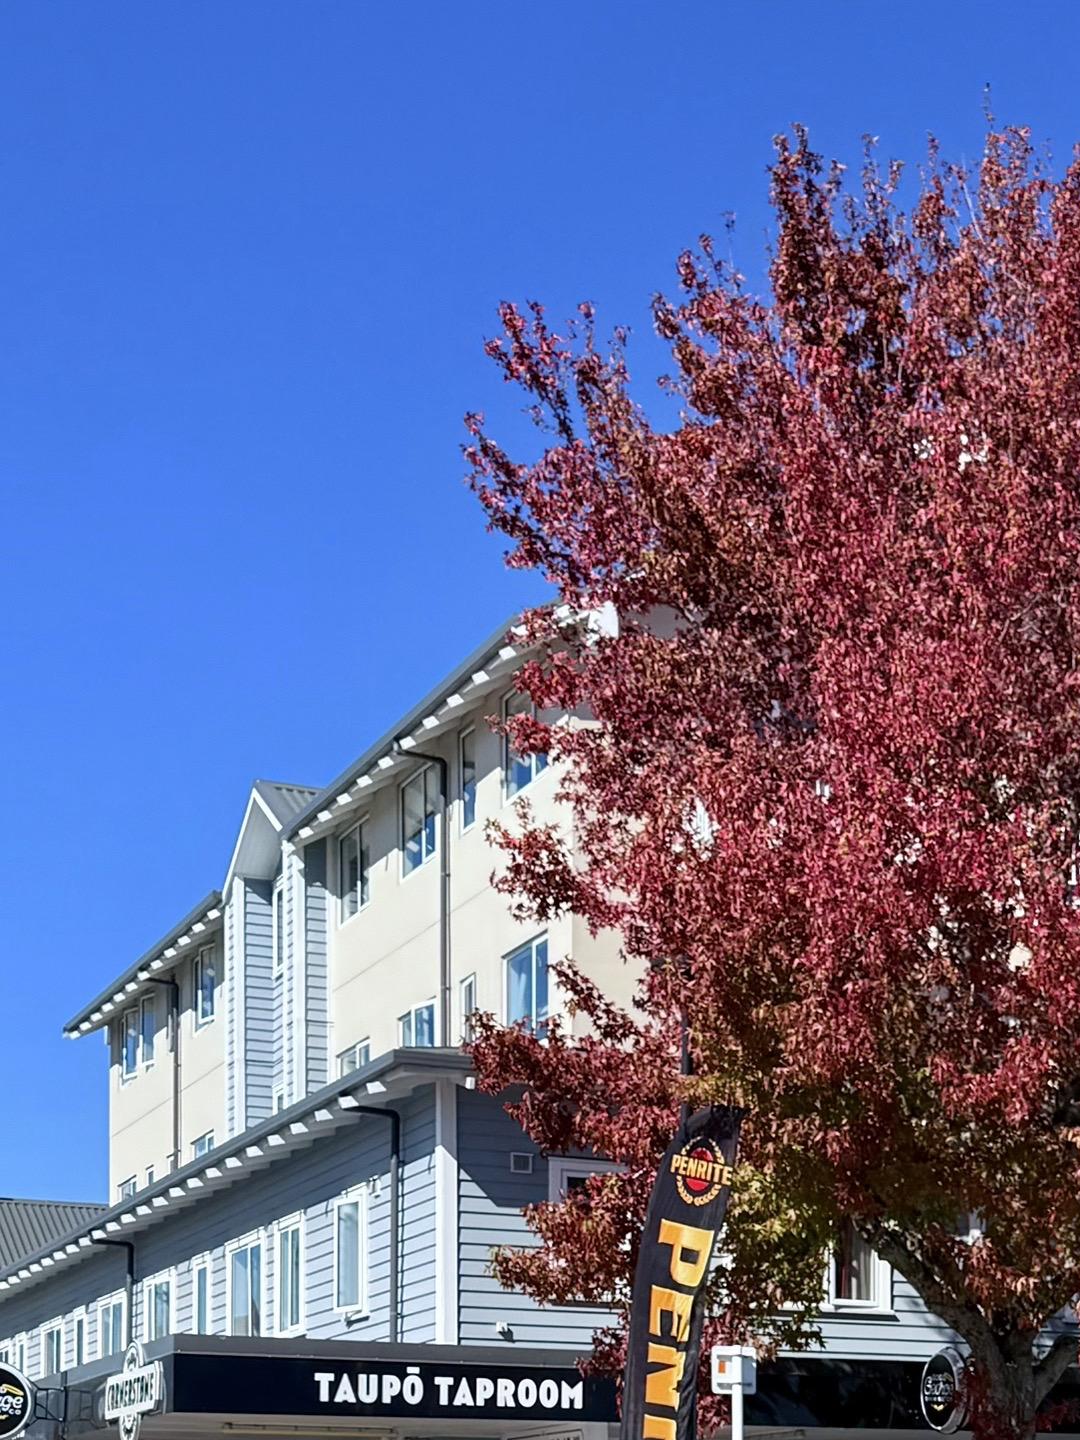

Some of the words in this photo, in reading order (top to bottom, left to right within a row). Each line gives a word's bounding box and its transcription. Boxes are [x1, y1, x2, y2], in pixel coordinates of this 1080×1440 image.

[670, 1154, 734, 1187] PENRITE
[314, 1367, 424, 1406] TAUPŌ
[434, 1376, 584, 1410] TAPROOM
